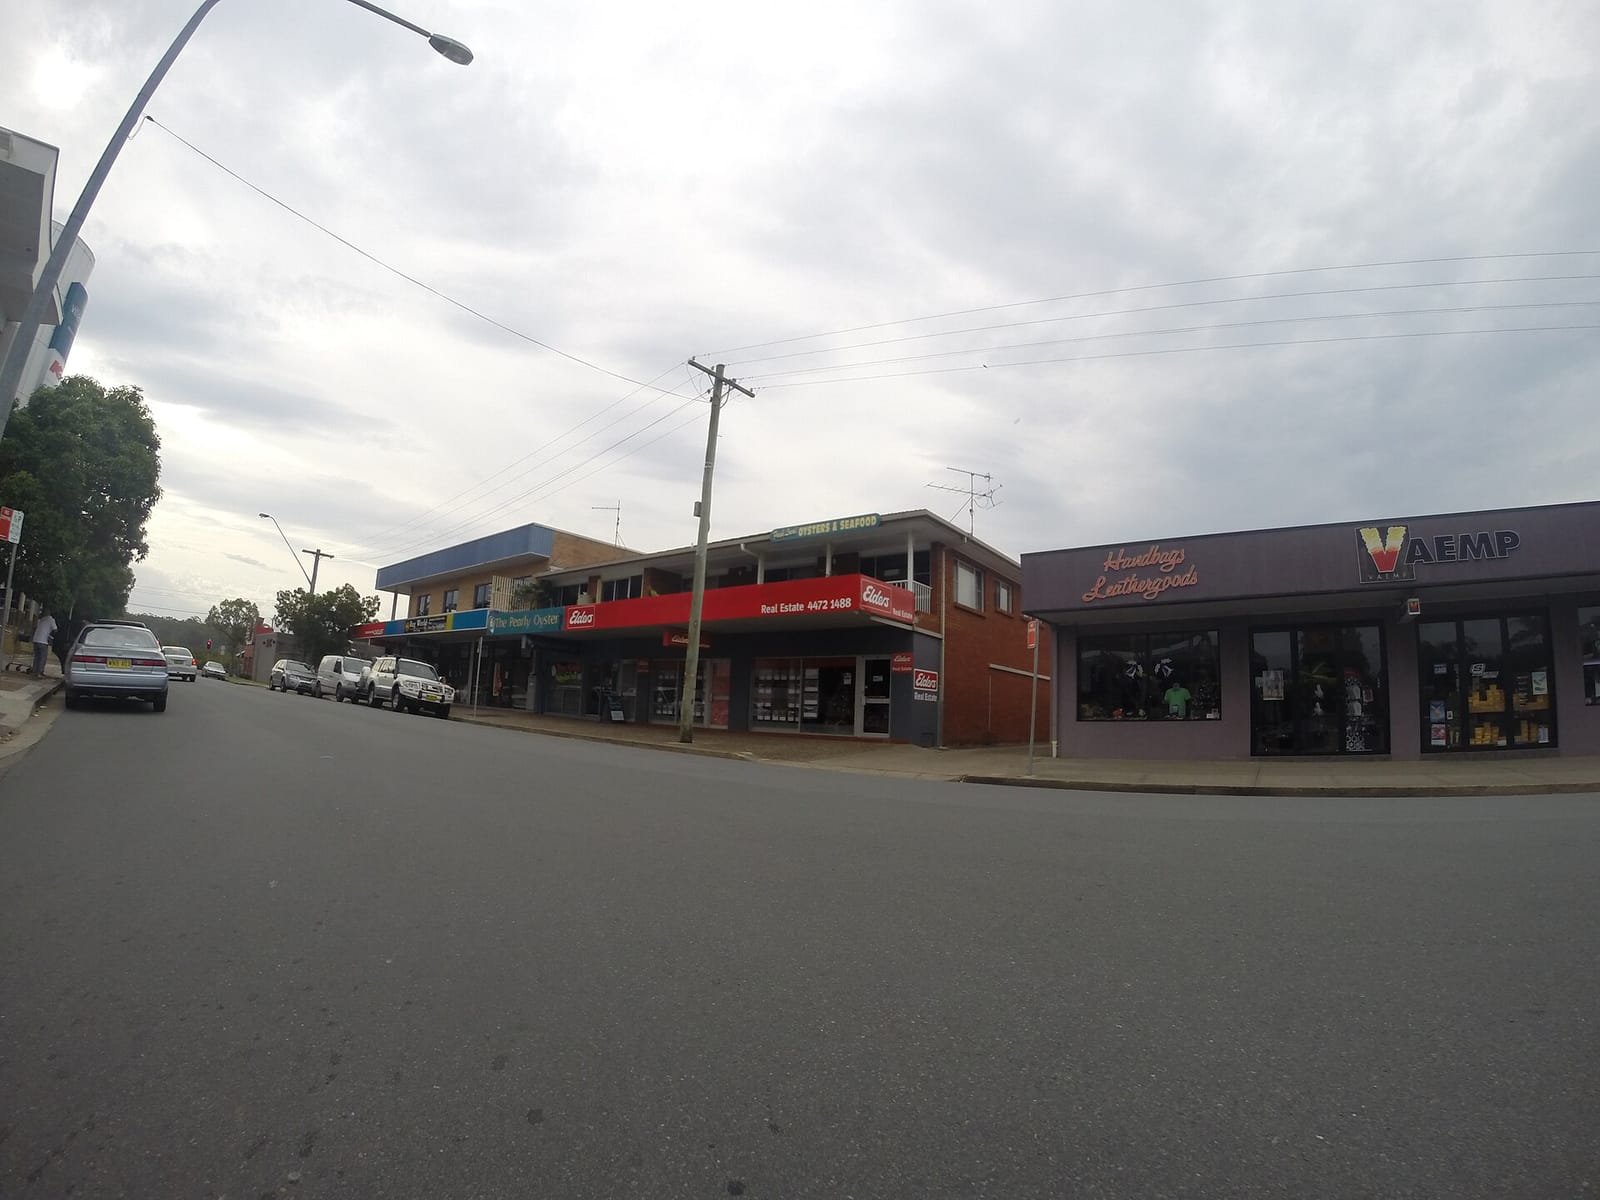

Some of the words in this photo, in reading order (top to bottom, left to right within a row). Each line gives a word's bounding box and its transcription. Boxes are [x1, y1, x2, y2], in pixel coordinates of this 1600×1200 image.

[798, 524, 830, 537] OYSTERS
[839, 515, 877, 530] SEAFOOD
[1103, 545, 1185, 573] Handbags
[1081, 564, 1198, 603] Leathergoods
[761, 603, 778, 614] Real
[780, 602, 805, 614] Estate
[807, 599, 828, 611] 4472
[830, 597, 852, 609] 1488
[863, 585, 890, 608] Elders
[533, 614, 560, 628] Oyster
[569, 610, 594, 625] Elders
[915, 673, 937, 688] Elders
